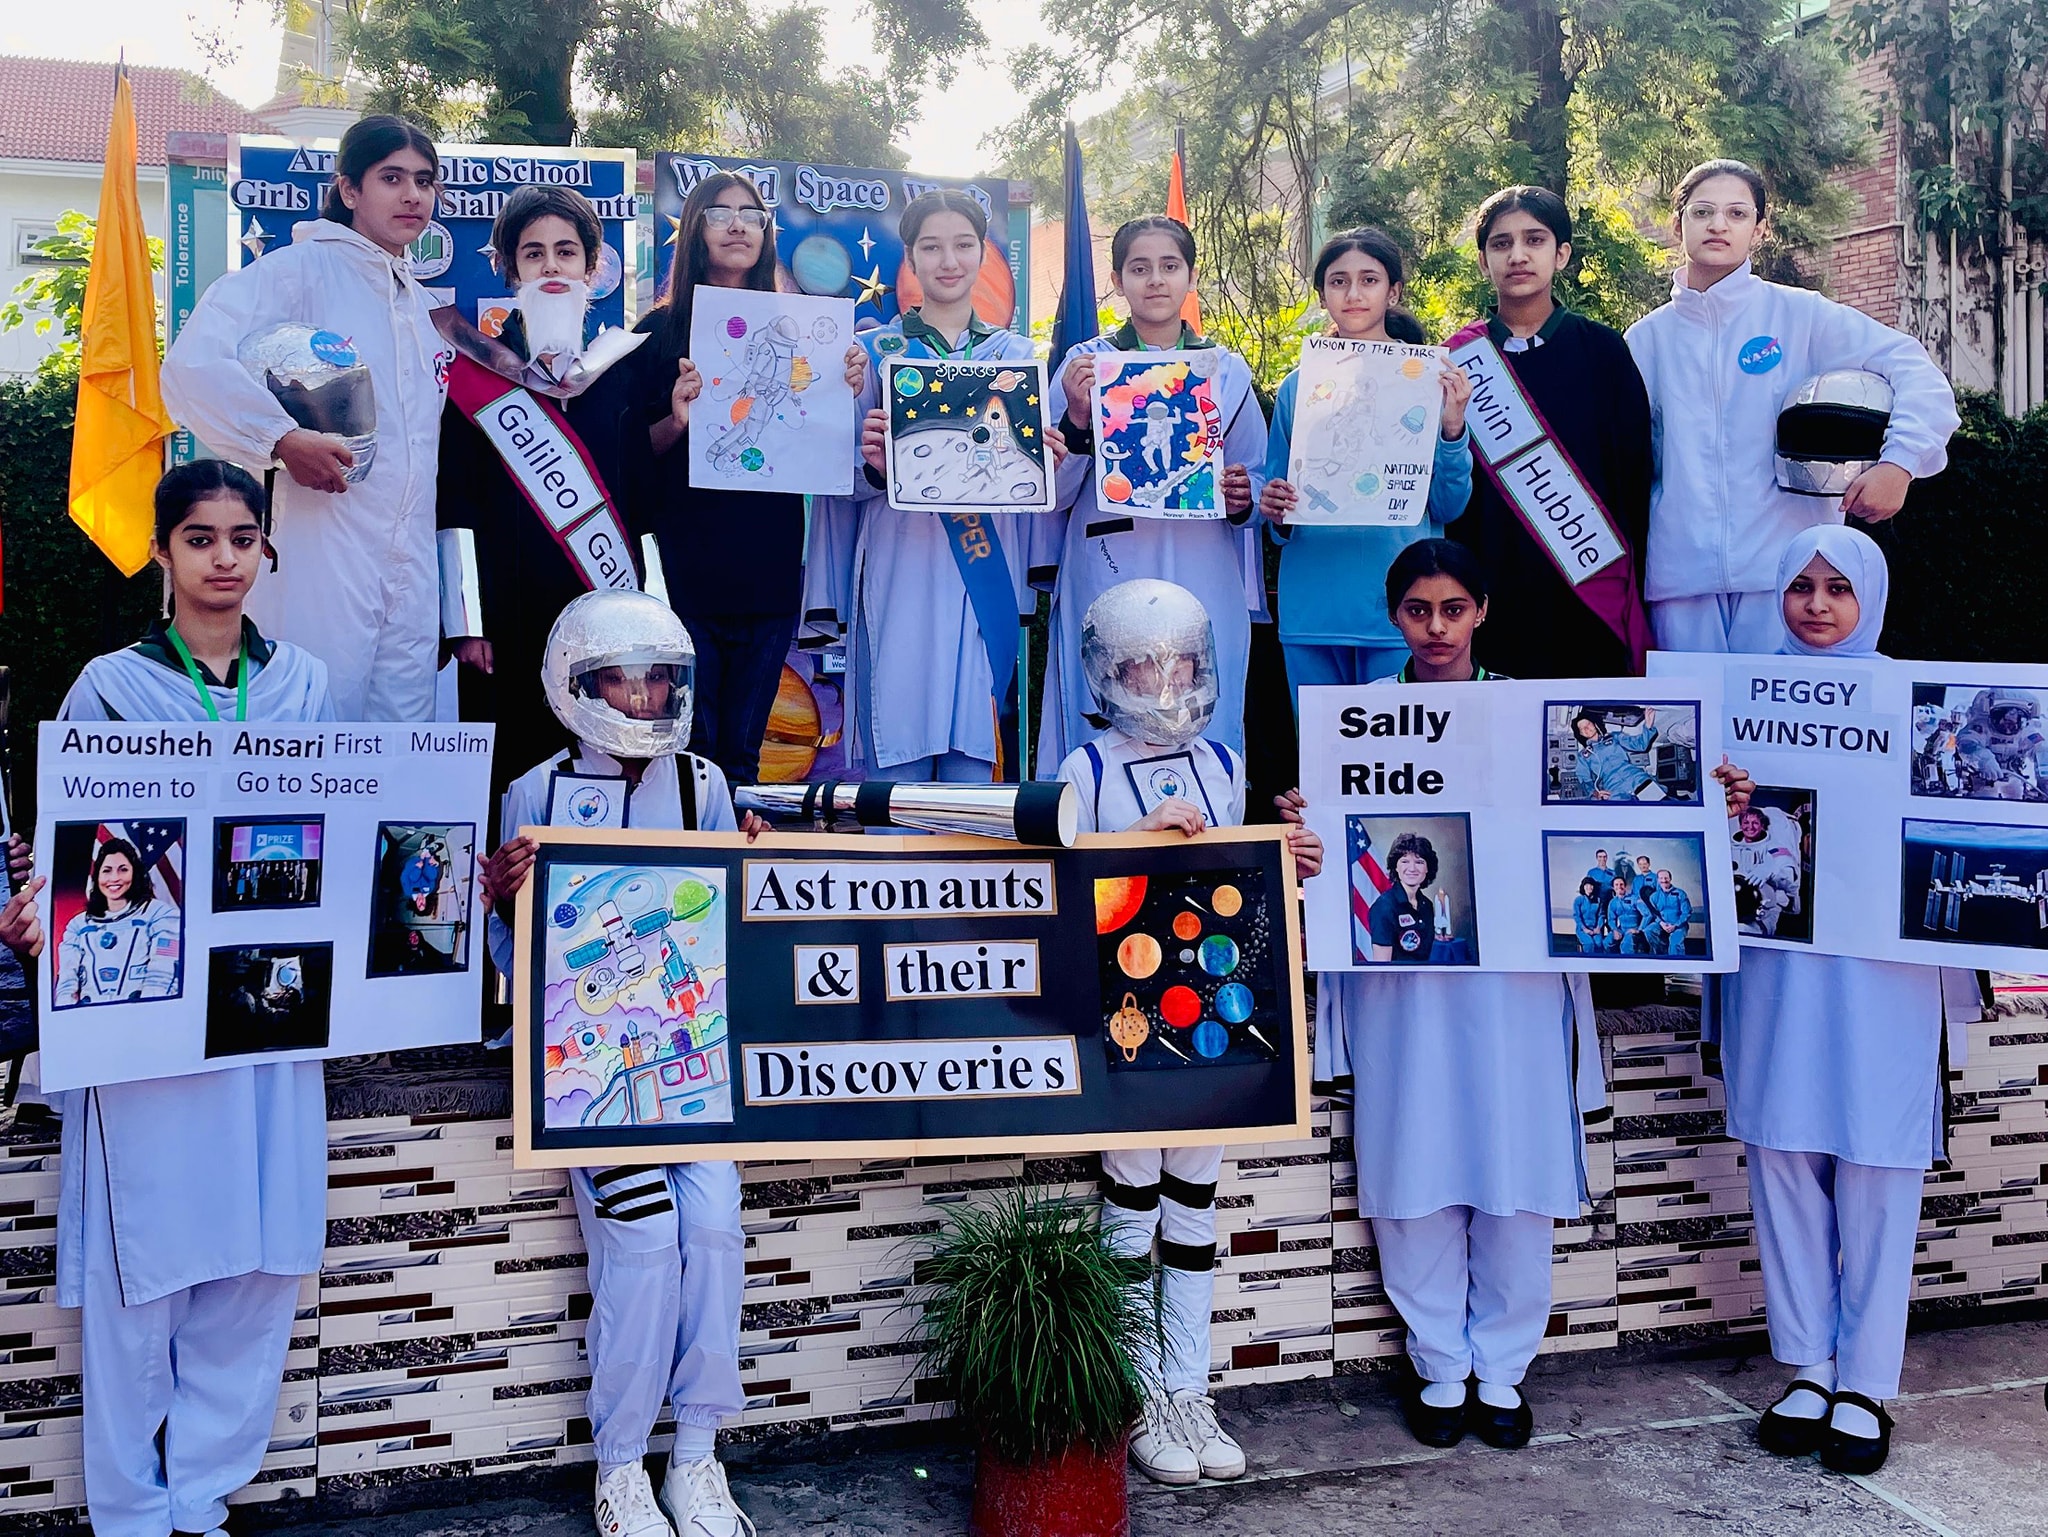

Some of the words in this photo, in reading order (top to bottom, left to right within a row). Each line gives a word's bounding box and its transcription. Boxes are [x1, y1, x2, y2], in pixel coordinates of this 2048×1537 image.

[494, 158, 590, 185] School
[231, 180, 309, 208] Girls
[799, 171, 885, 208] Space
[176, 203, 189, 287] Tolerance
[1309, 339, 1346, 351] VISION
[1351, 341, 1366, 353] TO
[1371, 344, 1394, 356] THE
[1401, 347, 1436, 359] STARS
[1742, 346, 1779, 365] NASA
[935, 363, 997, 381] Space
[497, 404, 579, 510] Galileo
[1384, 463, 1430, 475] NATIONAL
[1387, 479, 1417, 490] SPACE
[1388, 498, 1408, 510] DAY
[1516, 455, 1599, 568] Hubble
[1751, 678, 1857, 706] PEGGY
[1339, 704, 1451, 743] Sally
[1732, 717, 1889, 754] WINSTON
[61, 728, 212, 757] Anousheh
[233, 731, 324, 758] Ansari
[335, 733, 382, 754] First
[411, 732, 488, 753] Muslim
[63, 776, 161, 799] Women
[171, 778, 195, 799] to
[237, 771, 269, 793] Go
[277, 773, 302, 793] to
[310, 773, 379, 798] Space
[1341, 762, 1444, 795] Ride
[751, 866, 1044, 911] Astronauts
[808, 951, 854, 998] &
[897, 946, 1026, 994] their
[754, 1045, 1065, 1098] Discoveries
